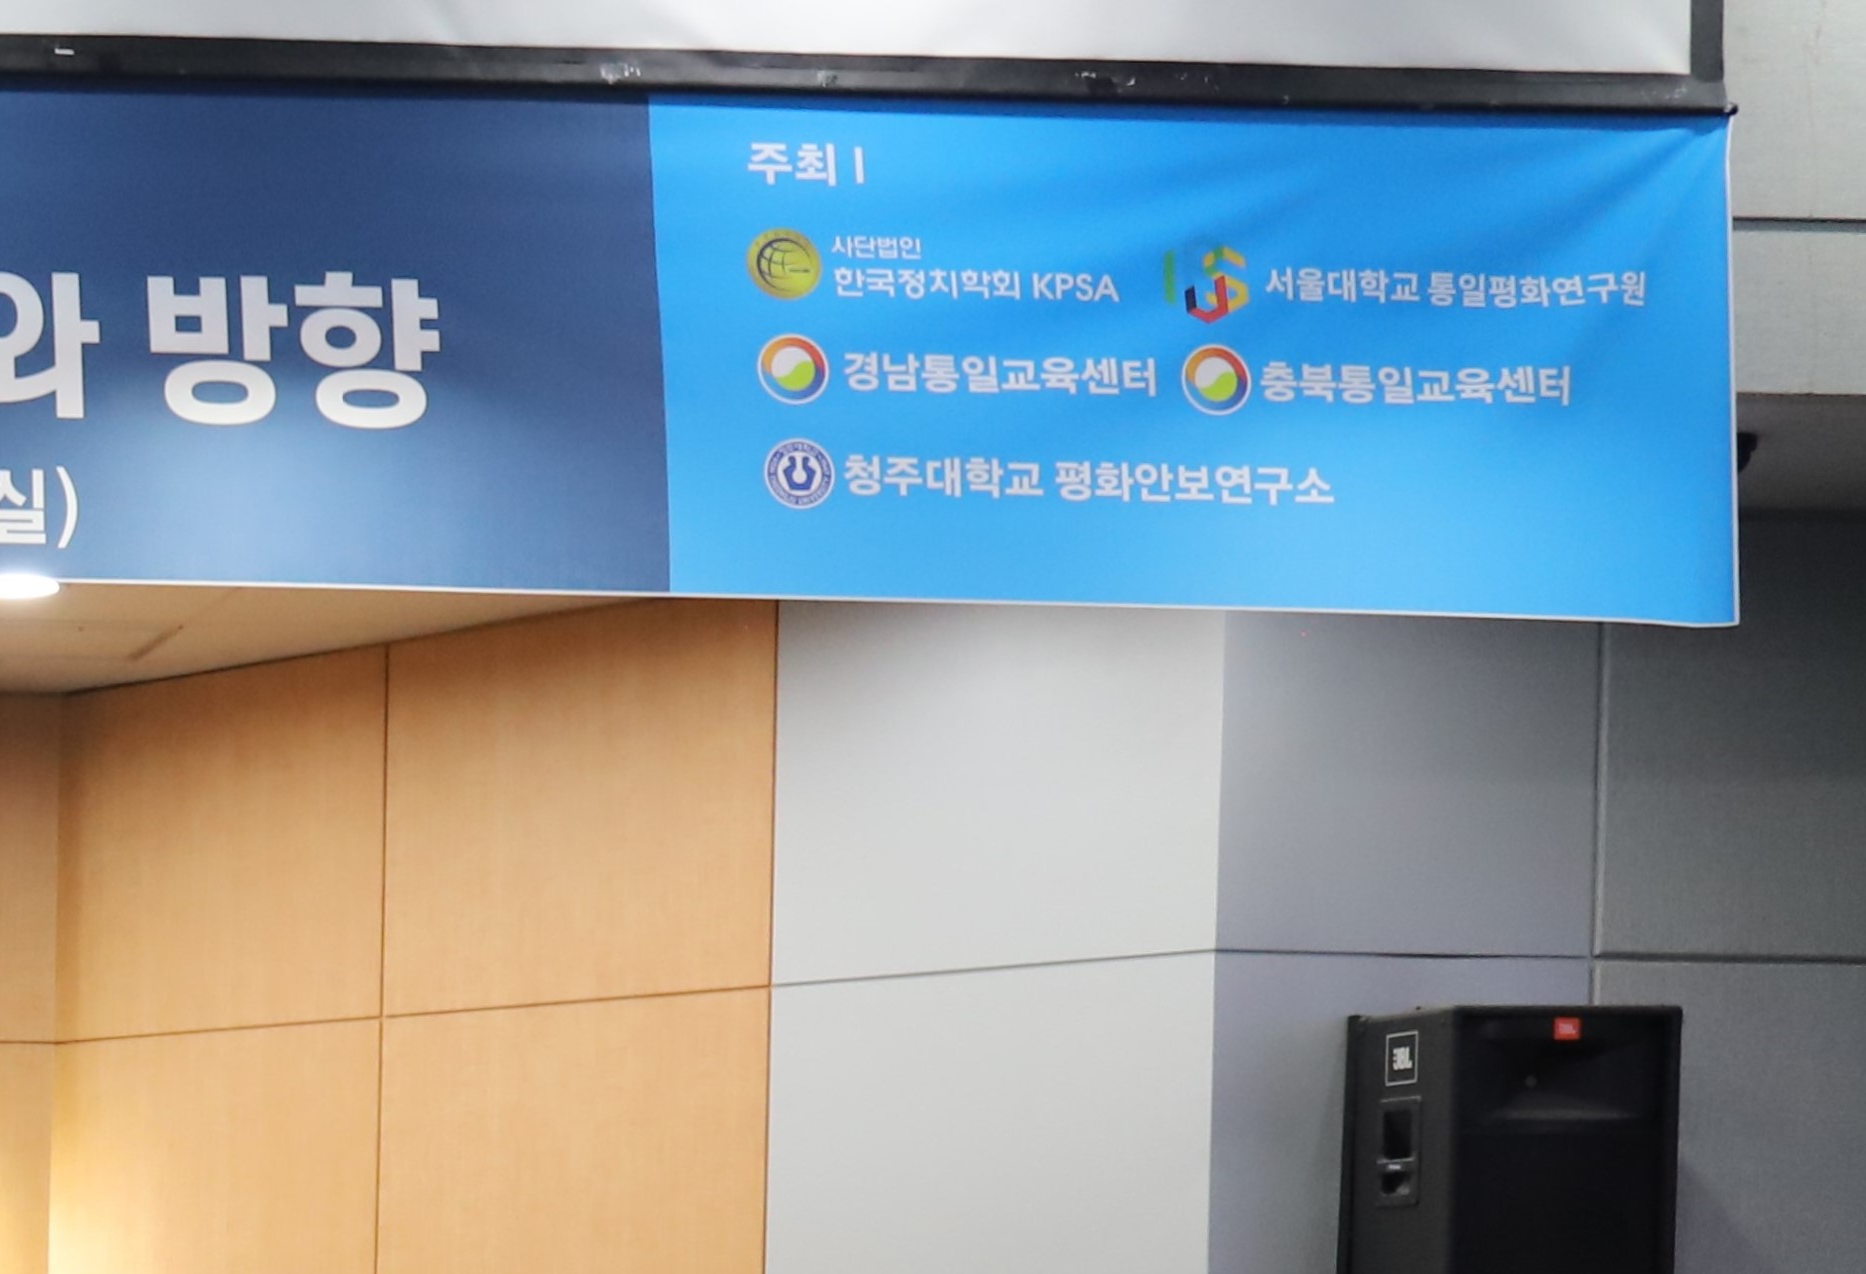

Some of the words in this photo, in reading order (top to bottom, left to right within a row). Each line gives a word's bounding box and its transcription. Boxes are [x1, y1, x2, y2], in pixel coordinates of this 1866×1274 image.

[747, 142, 837, 187] 주최
[831, 235, 922, 260] 사단법인
[833, 266, 1021, 300] 한국정치학회
[1031, 271, 1120, 303] KPSA
[1265, 266, 1421, 304] 서울대학교
[1427, 271, 1646, 309] 통일평화연구원
[147, 272, 440, 430] 방향
[843, 351, 1157, 397] 경남통일교육센터
[1259, 361, 1571, 406] 충북통일교육센터
[843, 454, 1045, 499] 청주대학교
[1055, 461, 1336, 507] 평화안보연구소
